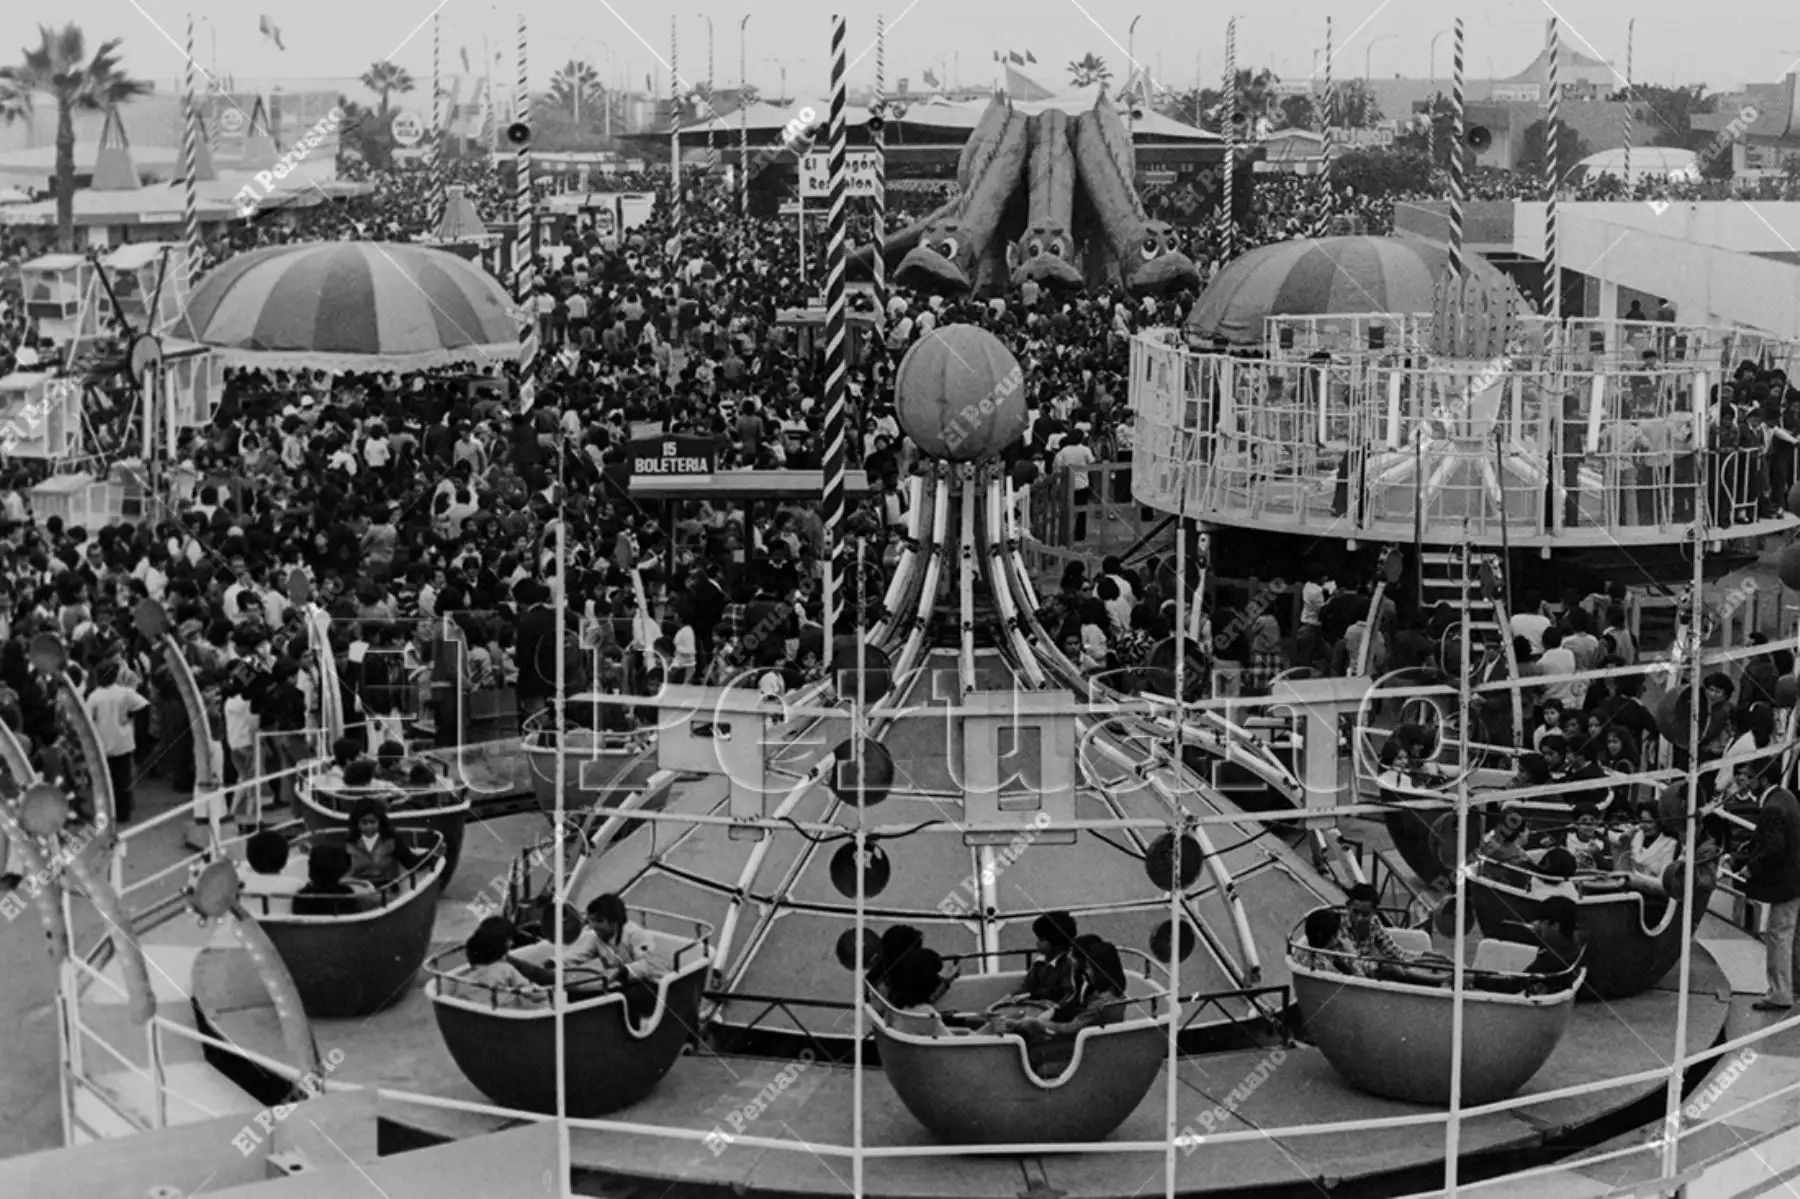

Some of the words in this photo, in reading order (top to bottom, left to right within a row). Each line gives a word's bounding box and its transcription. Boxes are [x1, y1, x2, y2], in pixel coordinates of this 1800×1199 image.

[804, 158, 816, 171] El
[663, 441, 677, 456] 15
[635, 457, 709, 473] BOLETERIA
